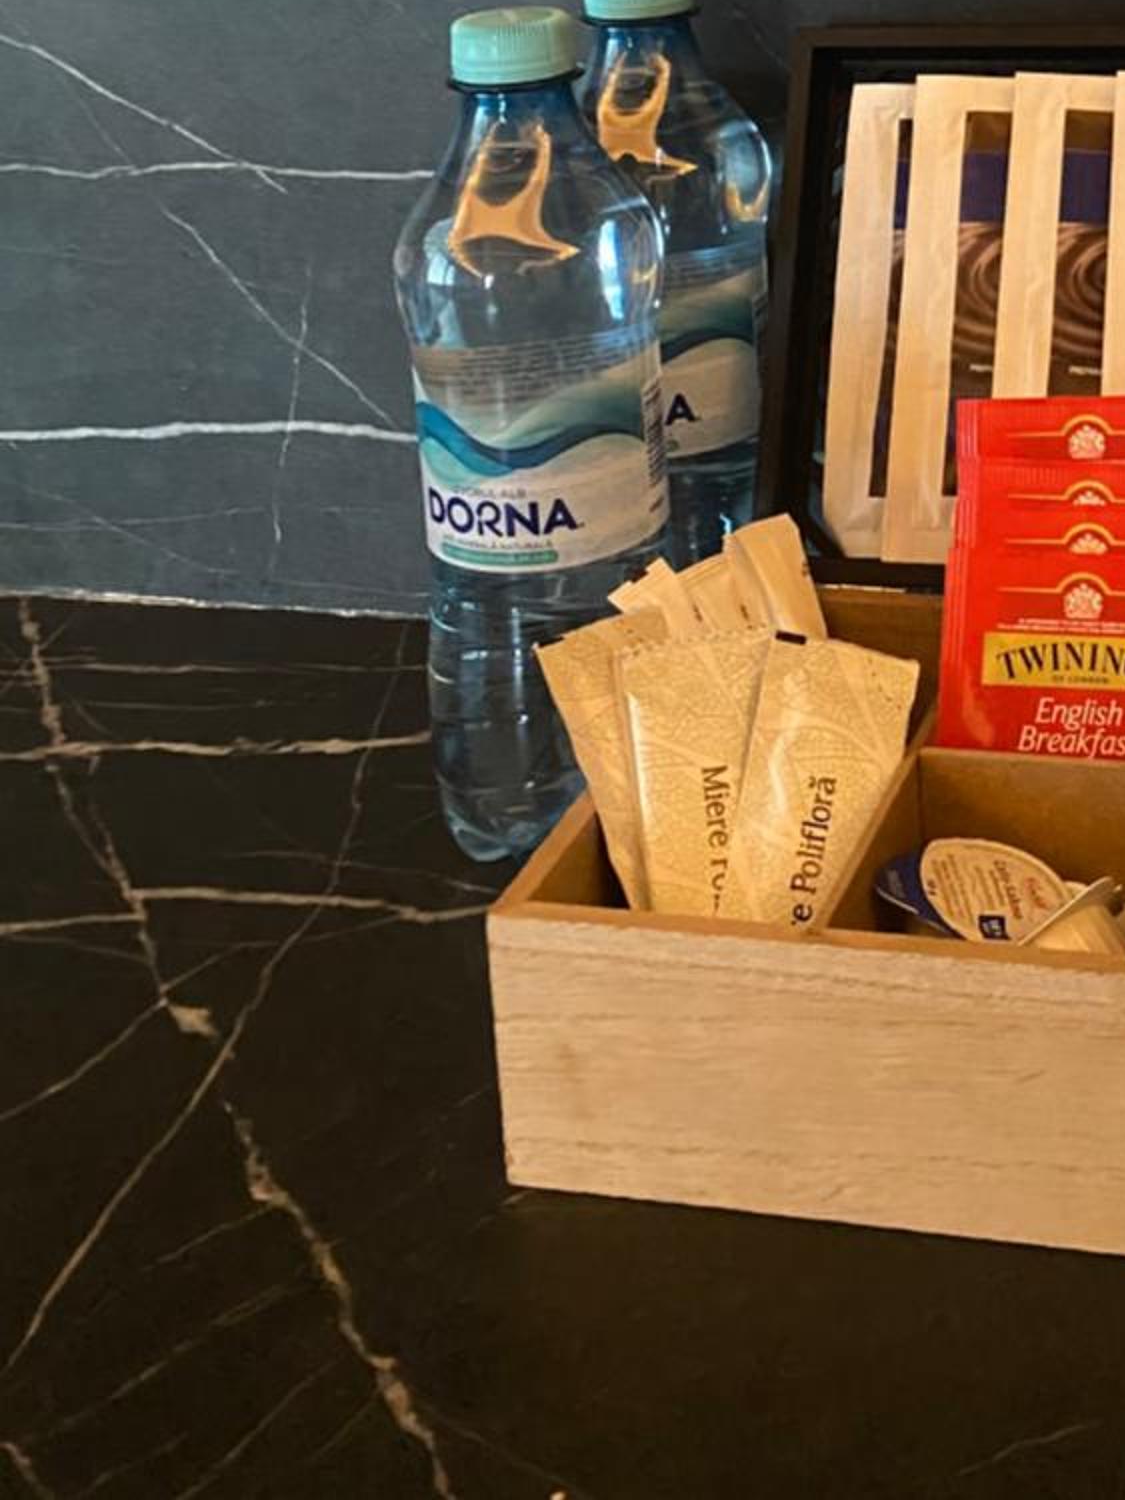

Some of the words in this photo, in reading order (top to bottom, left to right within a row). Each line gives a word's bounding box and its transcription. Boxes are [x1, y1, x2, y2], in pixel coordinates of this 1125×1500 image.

[428, 487, 578, 538] DORNA
[1035, 697, 1124, 730] English
[701, 765, 732, 849] Miere
[790, 775, 837, 896] Polifloră
